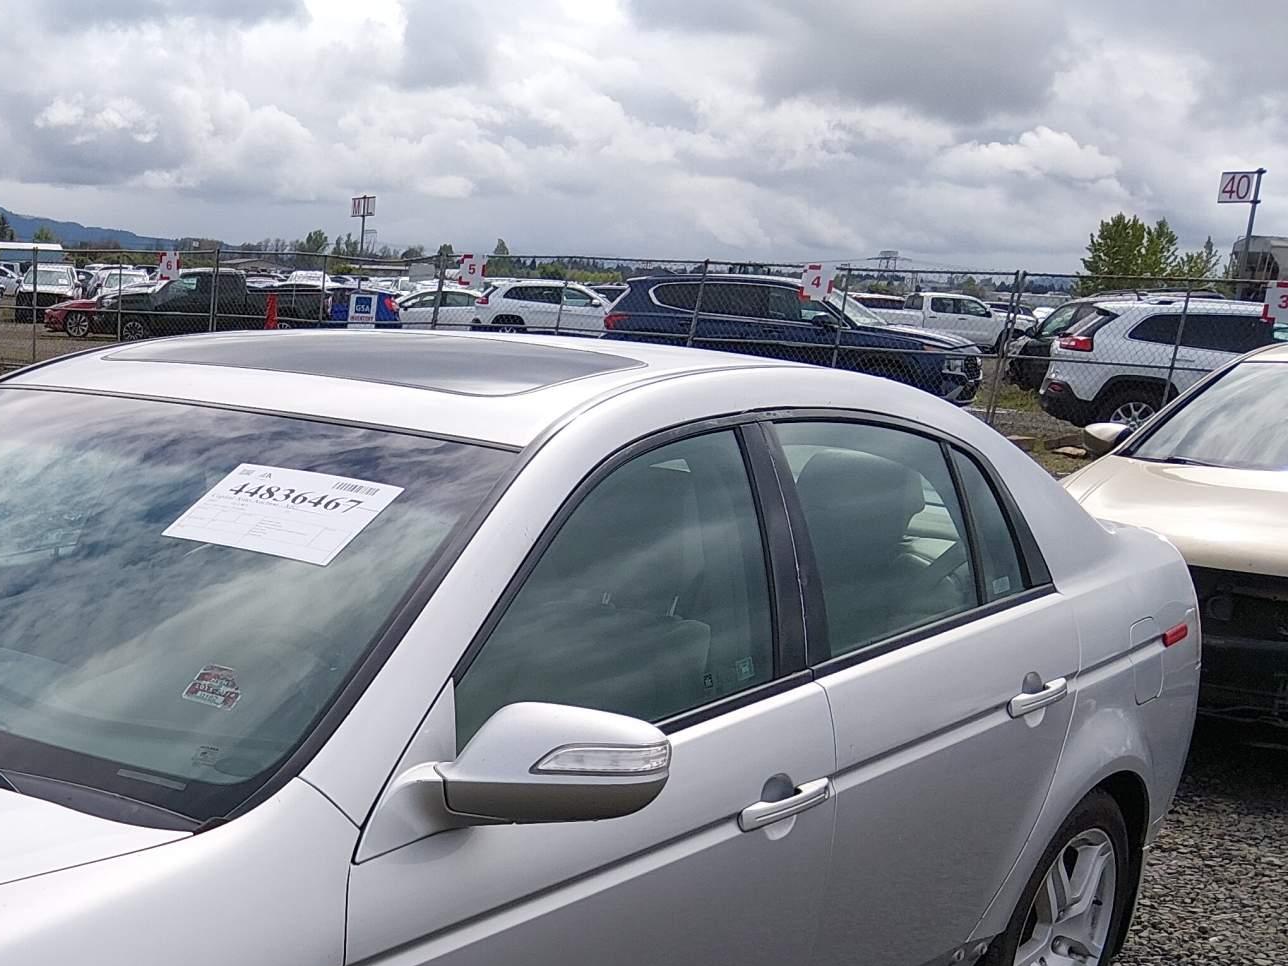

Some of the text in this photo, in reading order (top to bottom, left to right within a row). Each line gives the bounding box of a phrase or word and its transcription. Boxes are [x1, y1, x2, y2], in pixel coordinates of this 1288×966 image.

[1221, 174, 1251, 199] 40
[166, 260, 172, 271] 6
[468, 264, 476, 275] 5
[811, 275, 821, 288] 4
[1278, 294, 1288, 309] 3
[355, 304, 370, 313] GSA
[229, 482, 364, 513] 44836467
